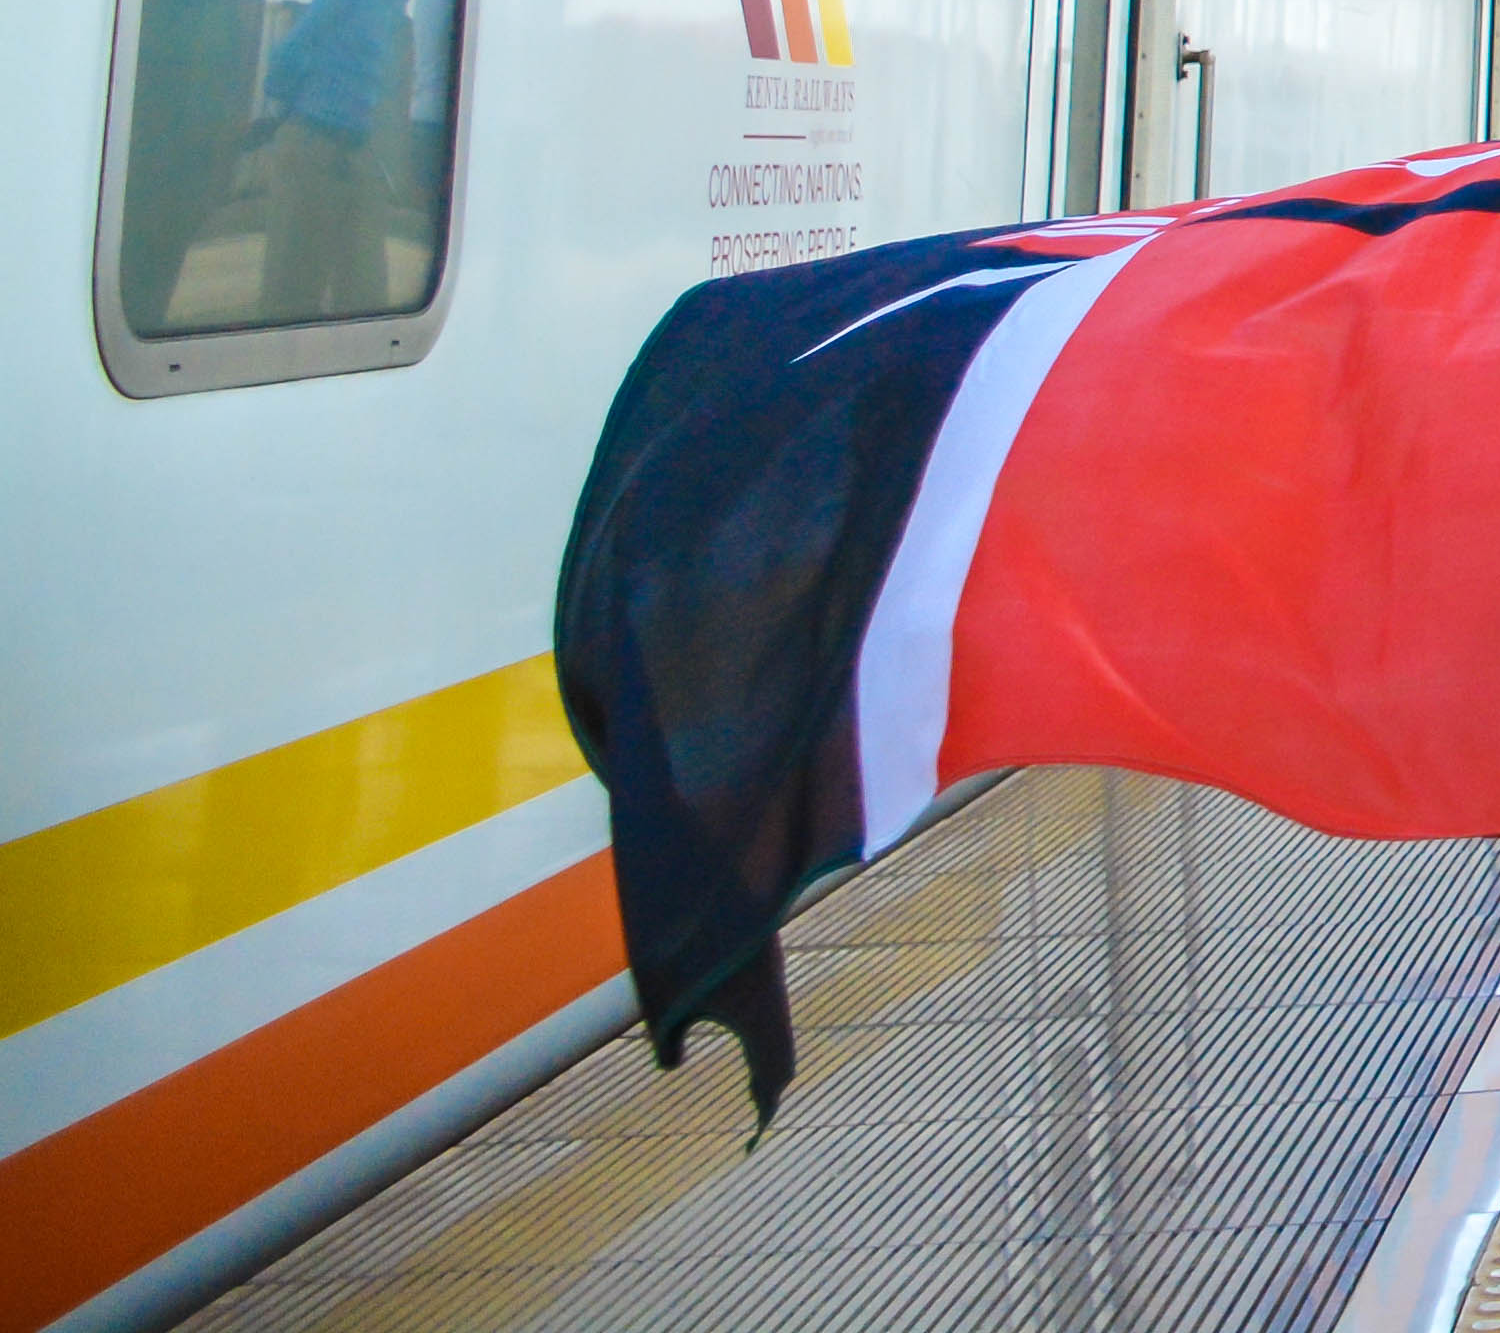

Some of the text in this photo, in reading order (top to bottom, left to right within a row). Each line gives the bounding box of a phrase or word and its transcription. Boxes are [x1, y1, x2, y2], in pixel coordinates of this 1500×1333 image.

[745, 75, 856, 112] KENYA RAILWAYS
[709, 164, 803, 208] CONNECTING
[711, 230, 804, 278] PROSPERING
